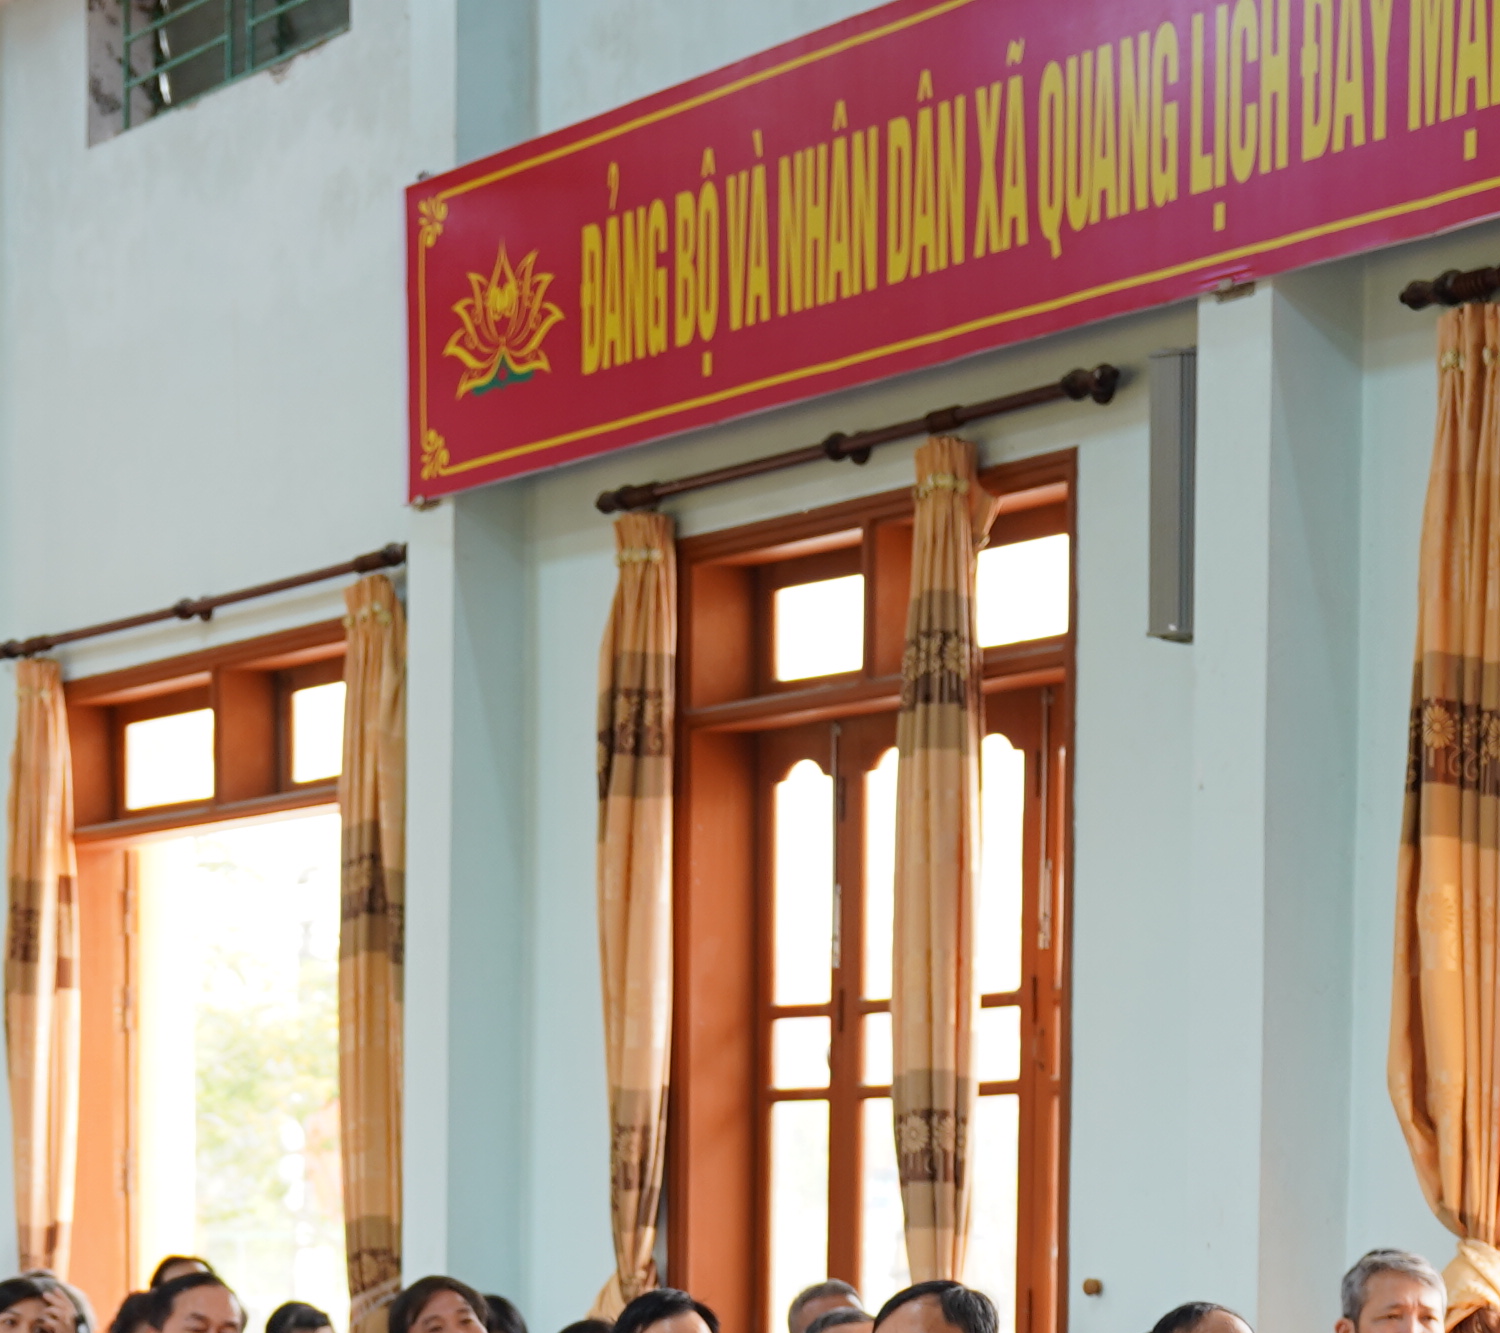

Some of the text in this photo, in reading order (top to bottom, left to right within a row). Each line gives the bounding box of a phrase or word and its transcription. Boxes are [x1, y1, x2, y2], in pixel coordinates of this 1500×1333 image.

[580, 160, 669, 376] ĐẢNG
[674, 146, 721, 377] BỘ
[725, 128, 771, 332] VÀ
[777, 99, 880, 317] NHÂN
[885, 68, 967, 286] DÂN
[972, 38, 1030, 260] XÃ
[1037, 20, 1179, 260] QUANG
[1189, 0, 1290, 232] LỊCH
